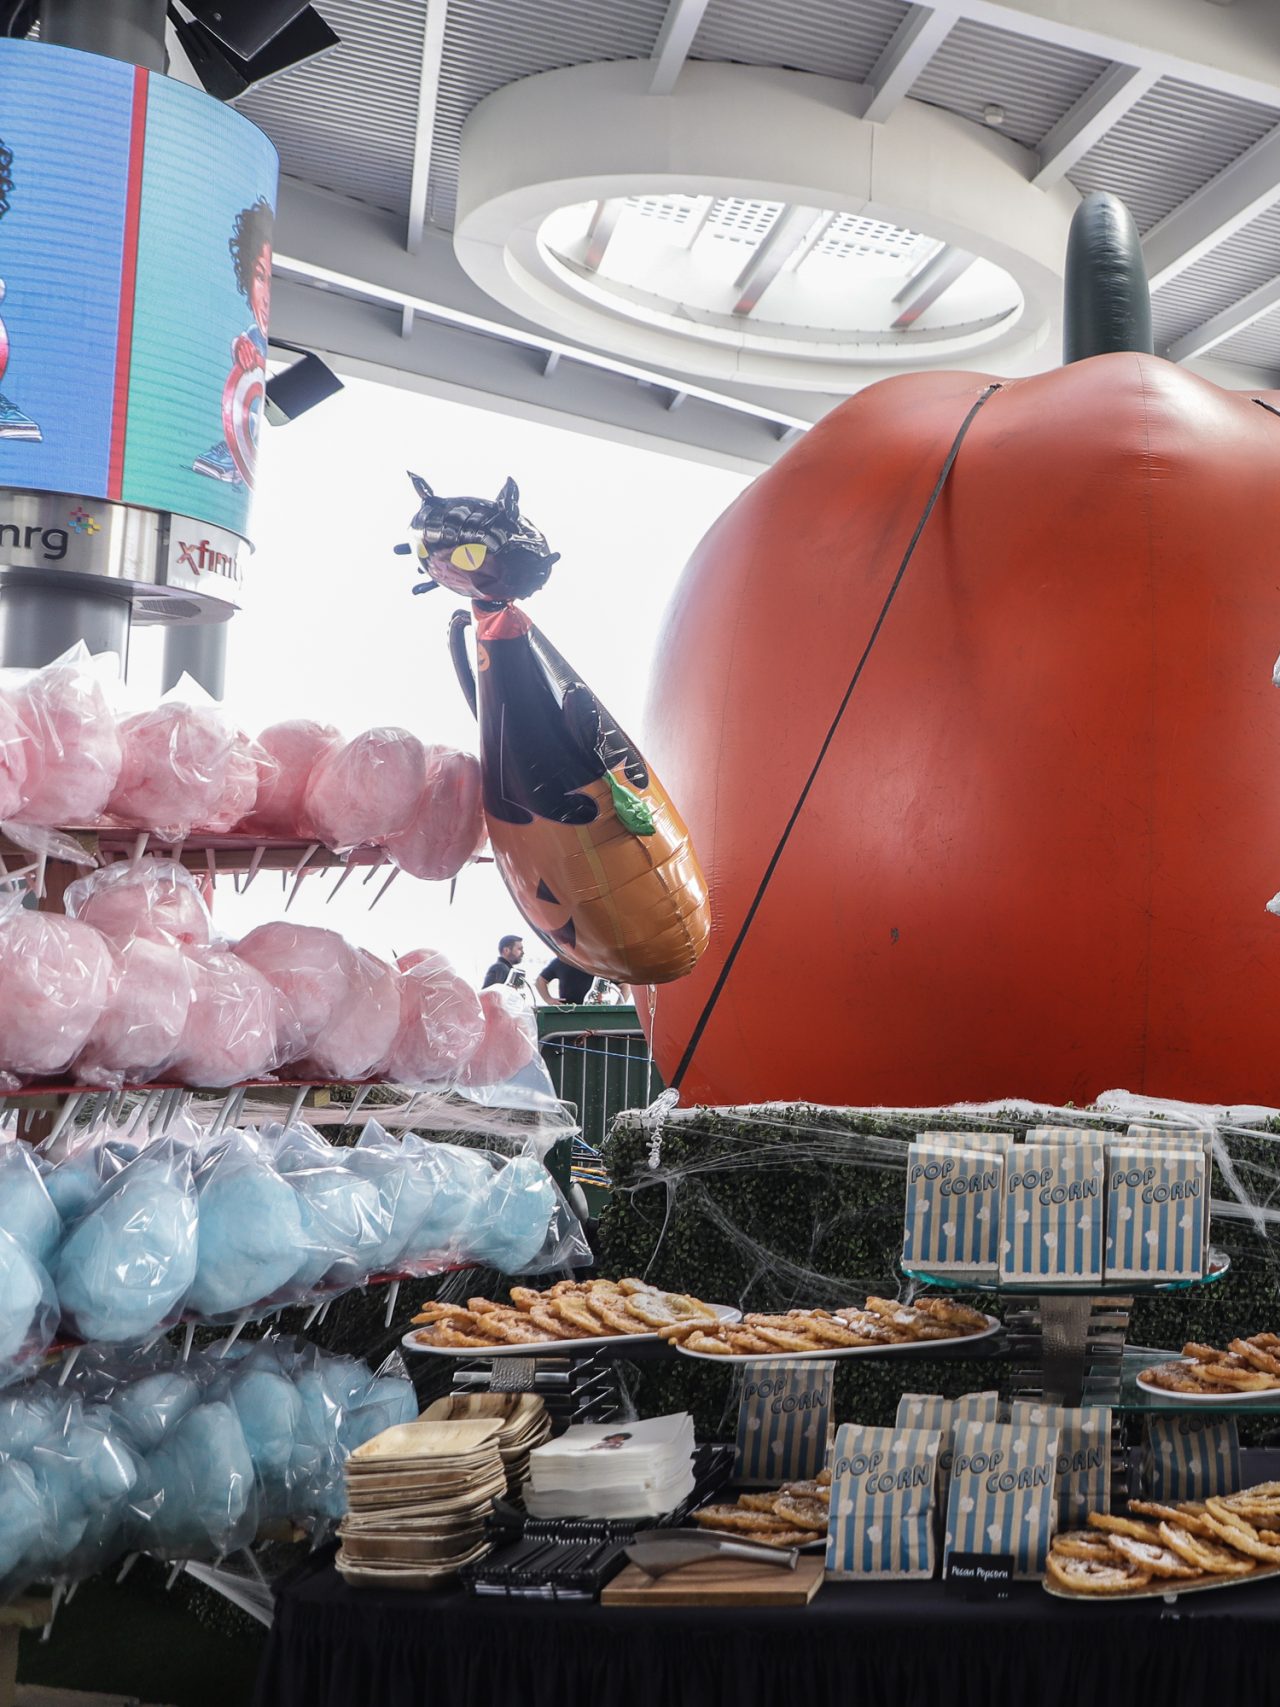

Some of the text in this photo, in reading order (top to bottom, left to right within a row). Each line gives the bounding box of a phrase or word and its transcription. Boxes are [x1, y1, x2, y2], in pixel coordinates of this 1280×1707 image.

[0, 524, 69, 560] nrg
[910, 1158, 955, 1184] POP
[940, 1168, 999, 1197] CORN
[1009, 1166, 1053, 1194] POP
[1112, 1166, 1156, 1192] POP
[1039, 1177, 1098, 1206] CORN
[1141, 1178, 1201, 1205] CORN
[744, 1377, 786, 1401] POP
[771, 1388, 827, 1414] CORN
[835, 1450, 883, 1480] POP
[953, 1448, 1004, 1478] POP
[1056, 1446, 1104, 1475] ORN
[865, 1463, 931, 1494] CORN
[985, 1463, 1050, 1494] CORN
[976, 1566, 1008, 1582] Popcorn
